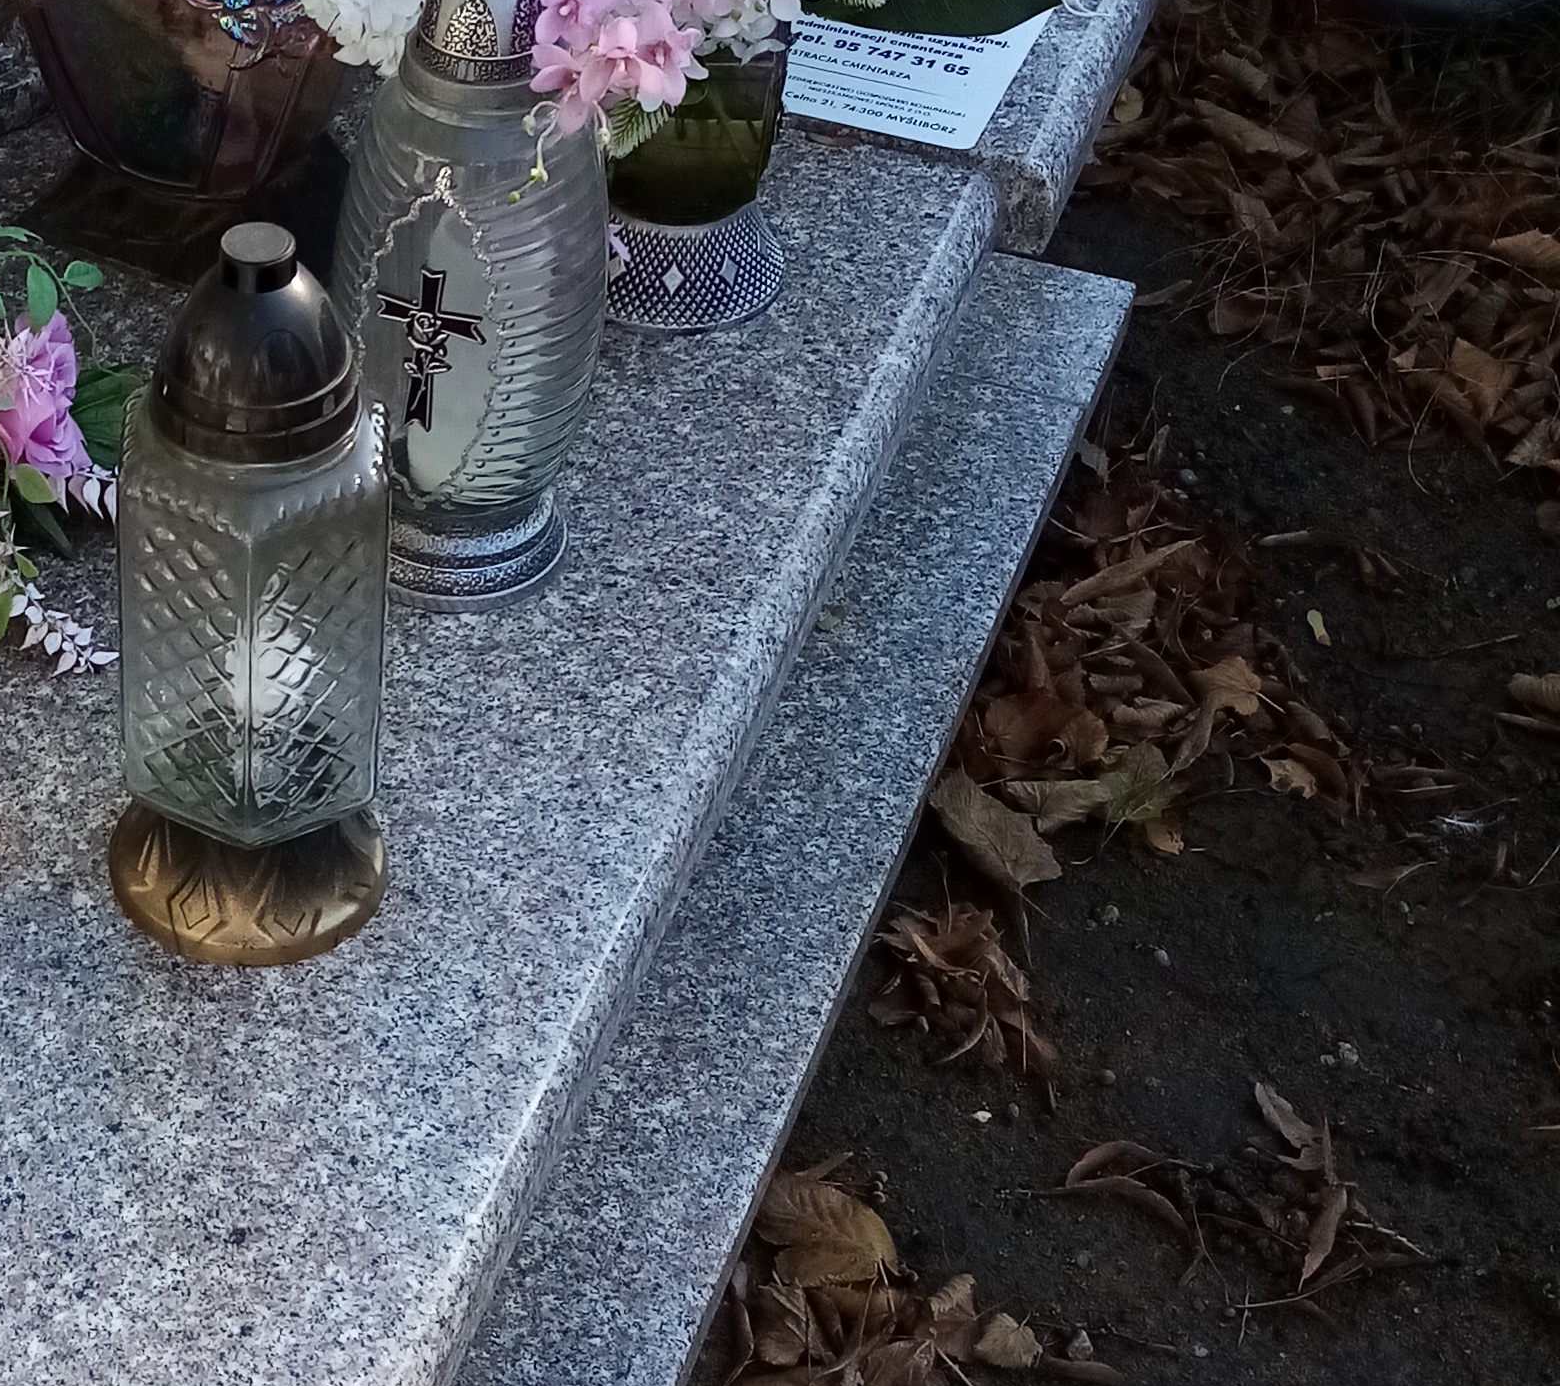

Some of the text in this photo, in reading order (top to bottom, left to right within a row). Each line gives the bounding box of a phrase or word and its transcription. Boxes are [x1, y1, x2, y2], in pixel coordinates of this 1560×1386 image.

[796, 19, 964, 60] administracji cmentarza
[833, 39, 862, 52] 95
[867, 45, 907, 62] 747
[910, 55, 937, 69] 31
[943, 63, 971, 76] 65
[841, 59, 912, 81] CMENTARZA
[820, 99, 837, 109] 21,
[841, 104, 883, 118] 74-300
[885, 113, 958, 134] MYŚLIBÓRZ
